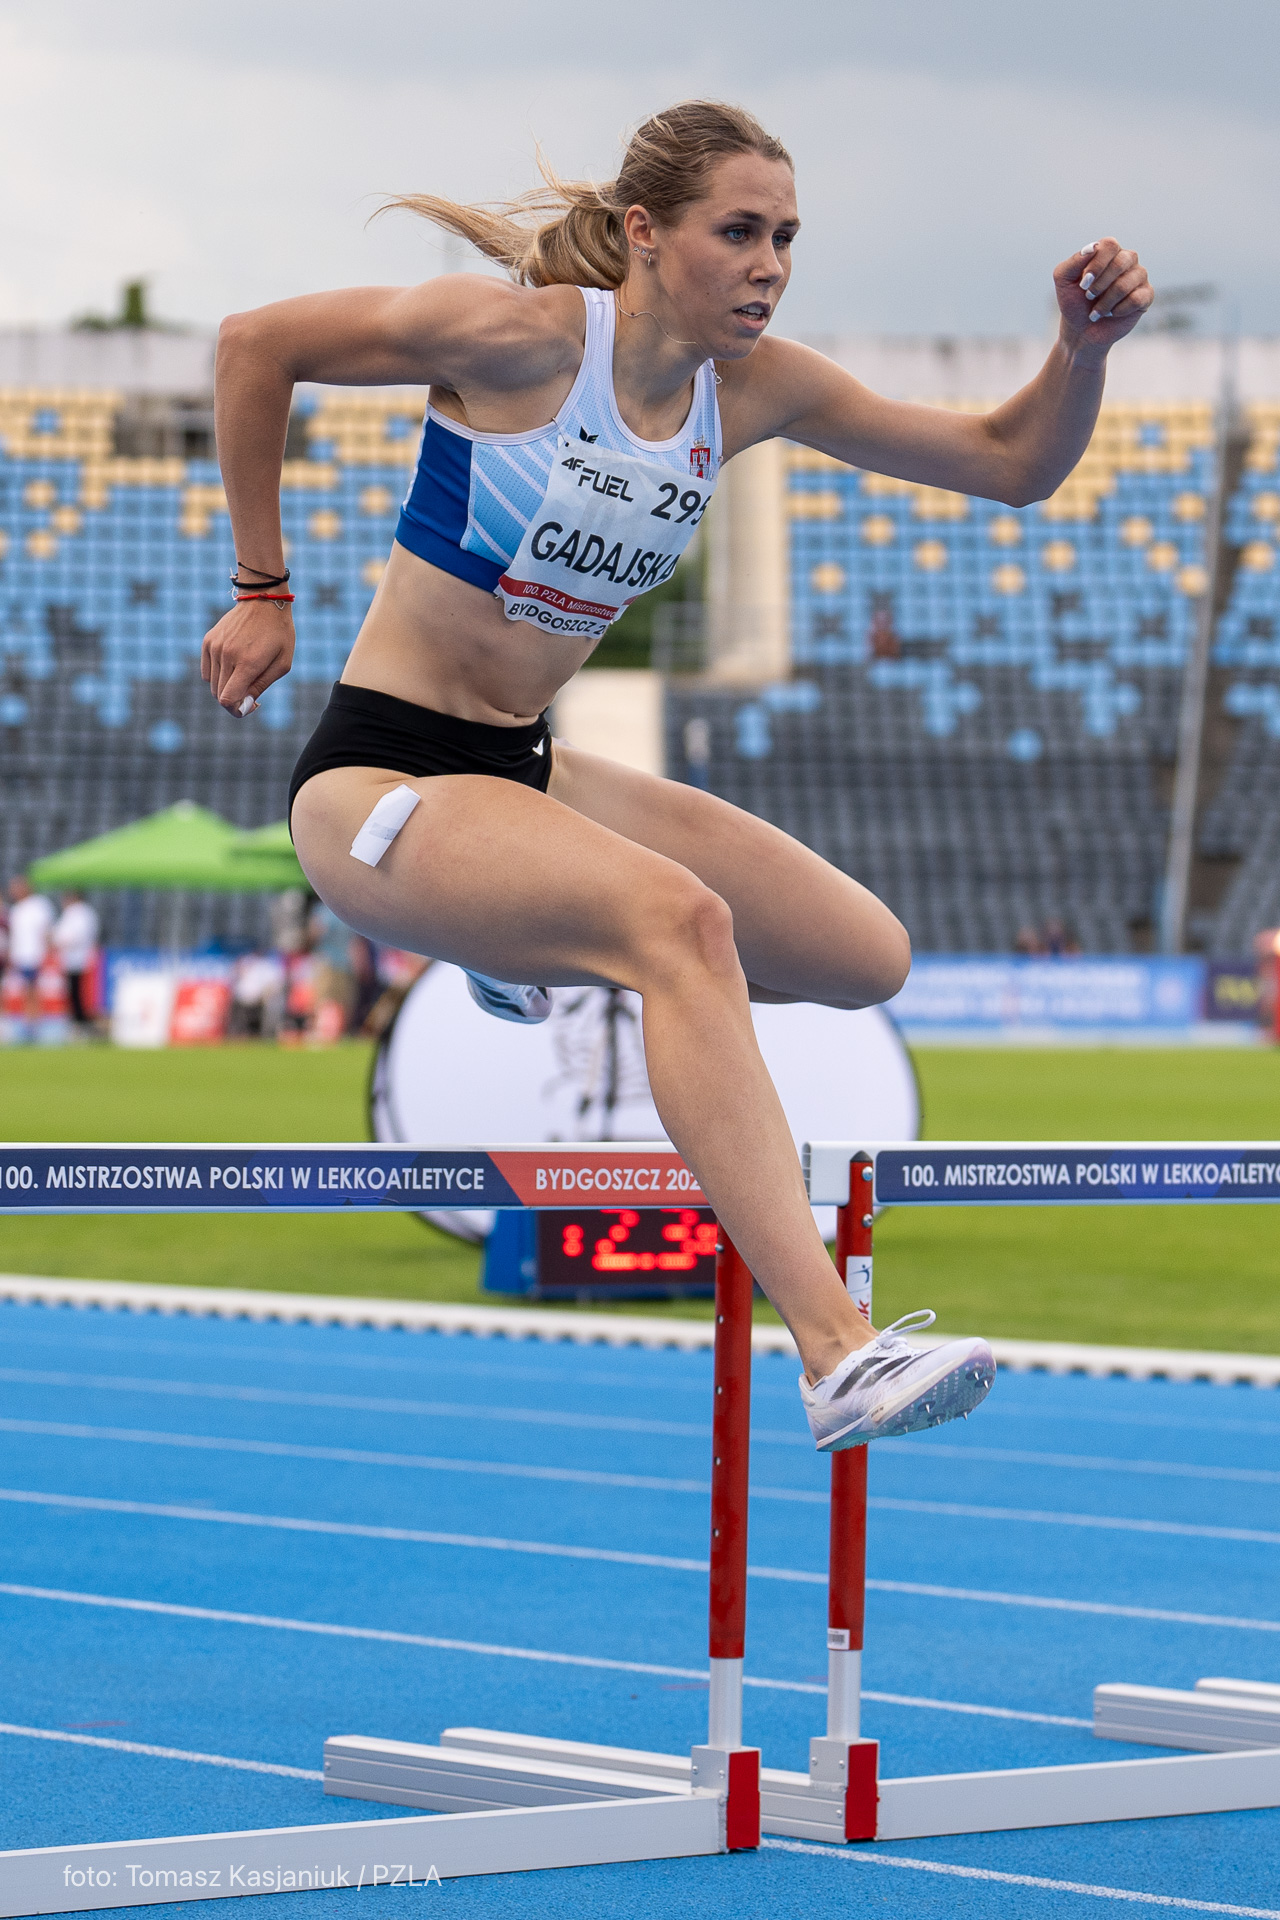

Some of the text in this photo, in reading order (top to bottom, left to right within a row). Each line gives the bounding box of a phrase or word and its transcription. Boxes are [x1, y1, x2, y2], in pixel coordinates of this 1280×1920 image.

[577, 466, 634, 502] FUEL
[530, 520, 681, 588] GADAJSKA
[522, 584, 538, 597] 100.
[541, 589, 566, 607] PZLA
[507, 602, 606, 636] BYDGOSZCZ 2
[45, 1165, 203, 1190] MISTRZOSTWA
[209, 1166, 284, 1190] POLSKI
[290, 1166, 312, 1189] W
[317, 1166, 485, 1190] LEKKOATLETYCE
[535, 1167, 661, 1191] BYDGOSZCZ
[901, 1164, 939, 1188] 100.
[944, 1163, 1071, 1187] MISTRZOSTWA
[1076, 1163, 1137, 1186] POLSKI
[1141, 1163, 1159, 1185] W
